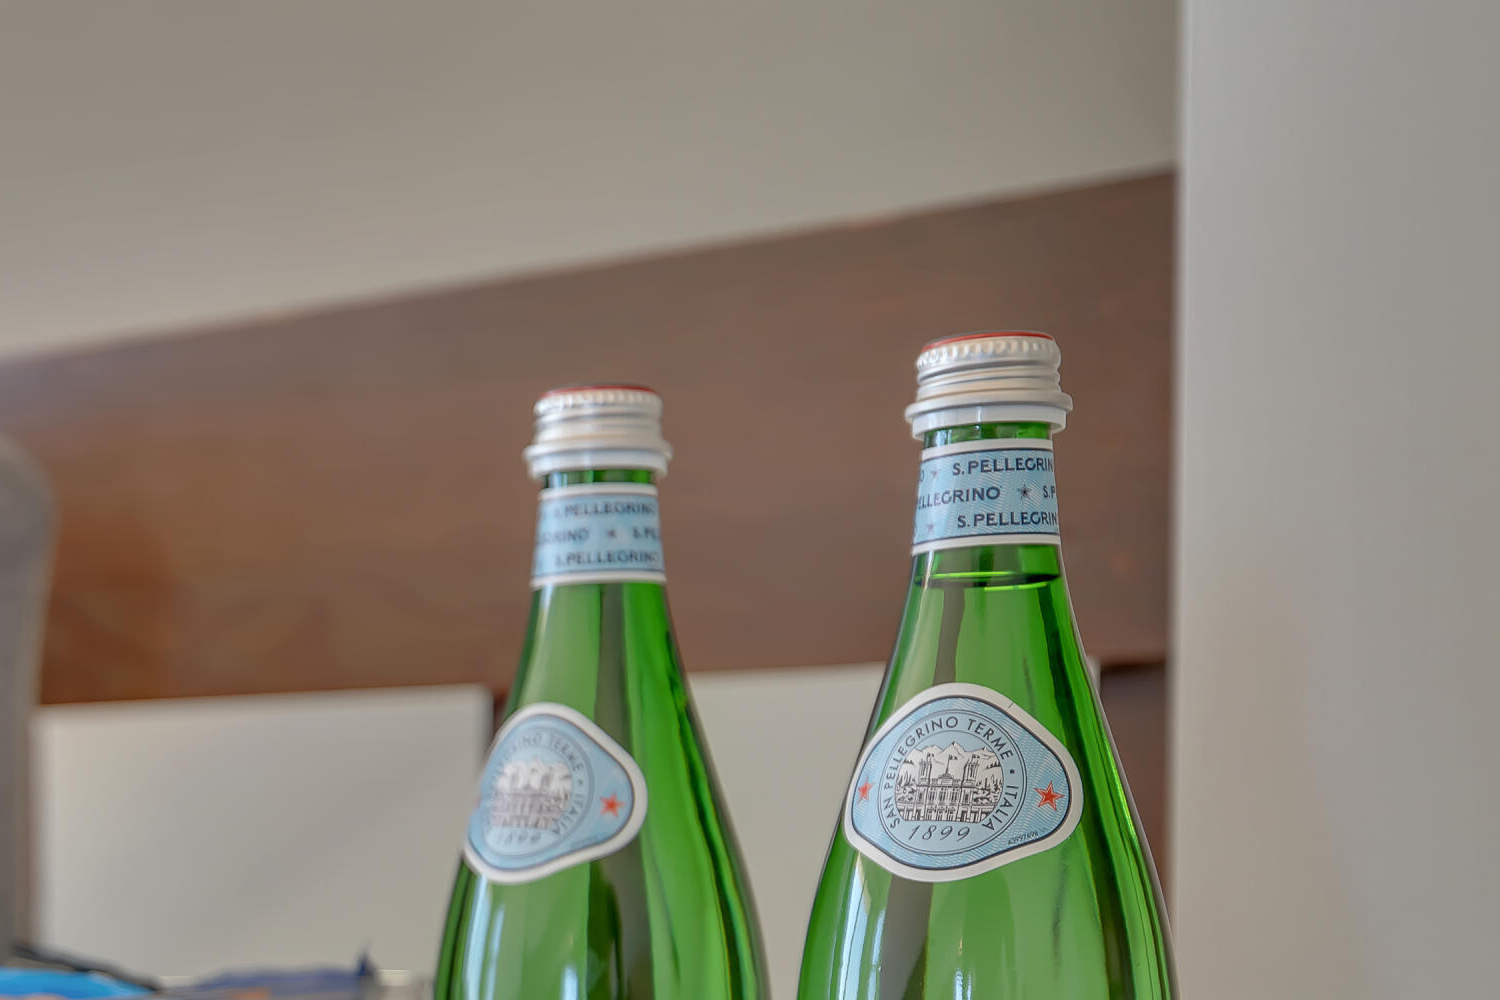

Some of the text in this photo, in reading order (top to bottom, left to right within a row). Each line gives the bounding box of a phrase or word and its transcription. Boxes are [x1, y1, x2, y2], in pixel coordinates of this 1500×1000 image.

[884, 716, 1017, 831] SAN PELLEGRINO TERME ITALIA
[908, 825, 971, 841] 1899
